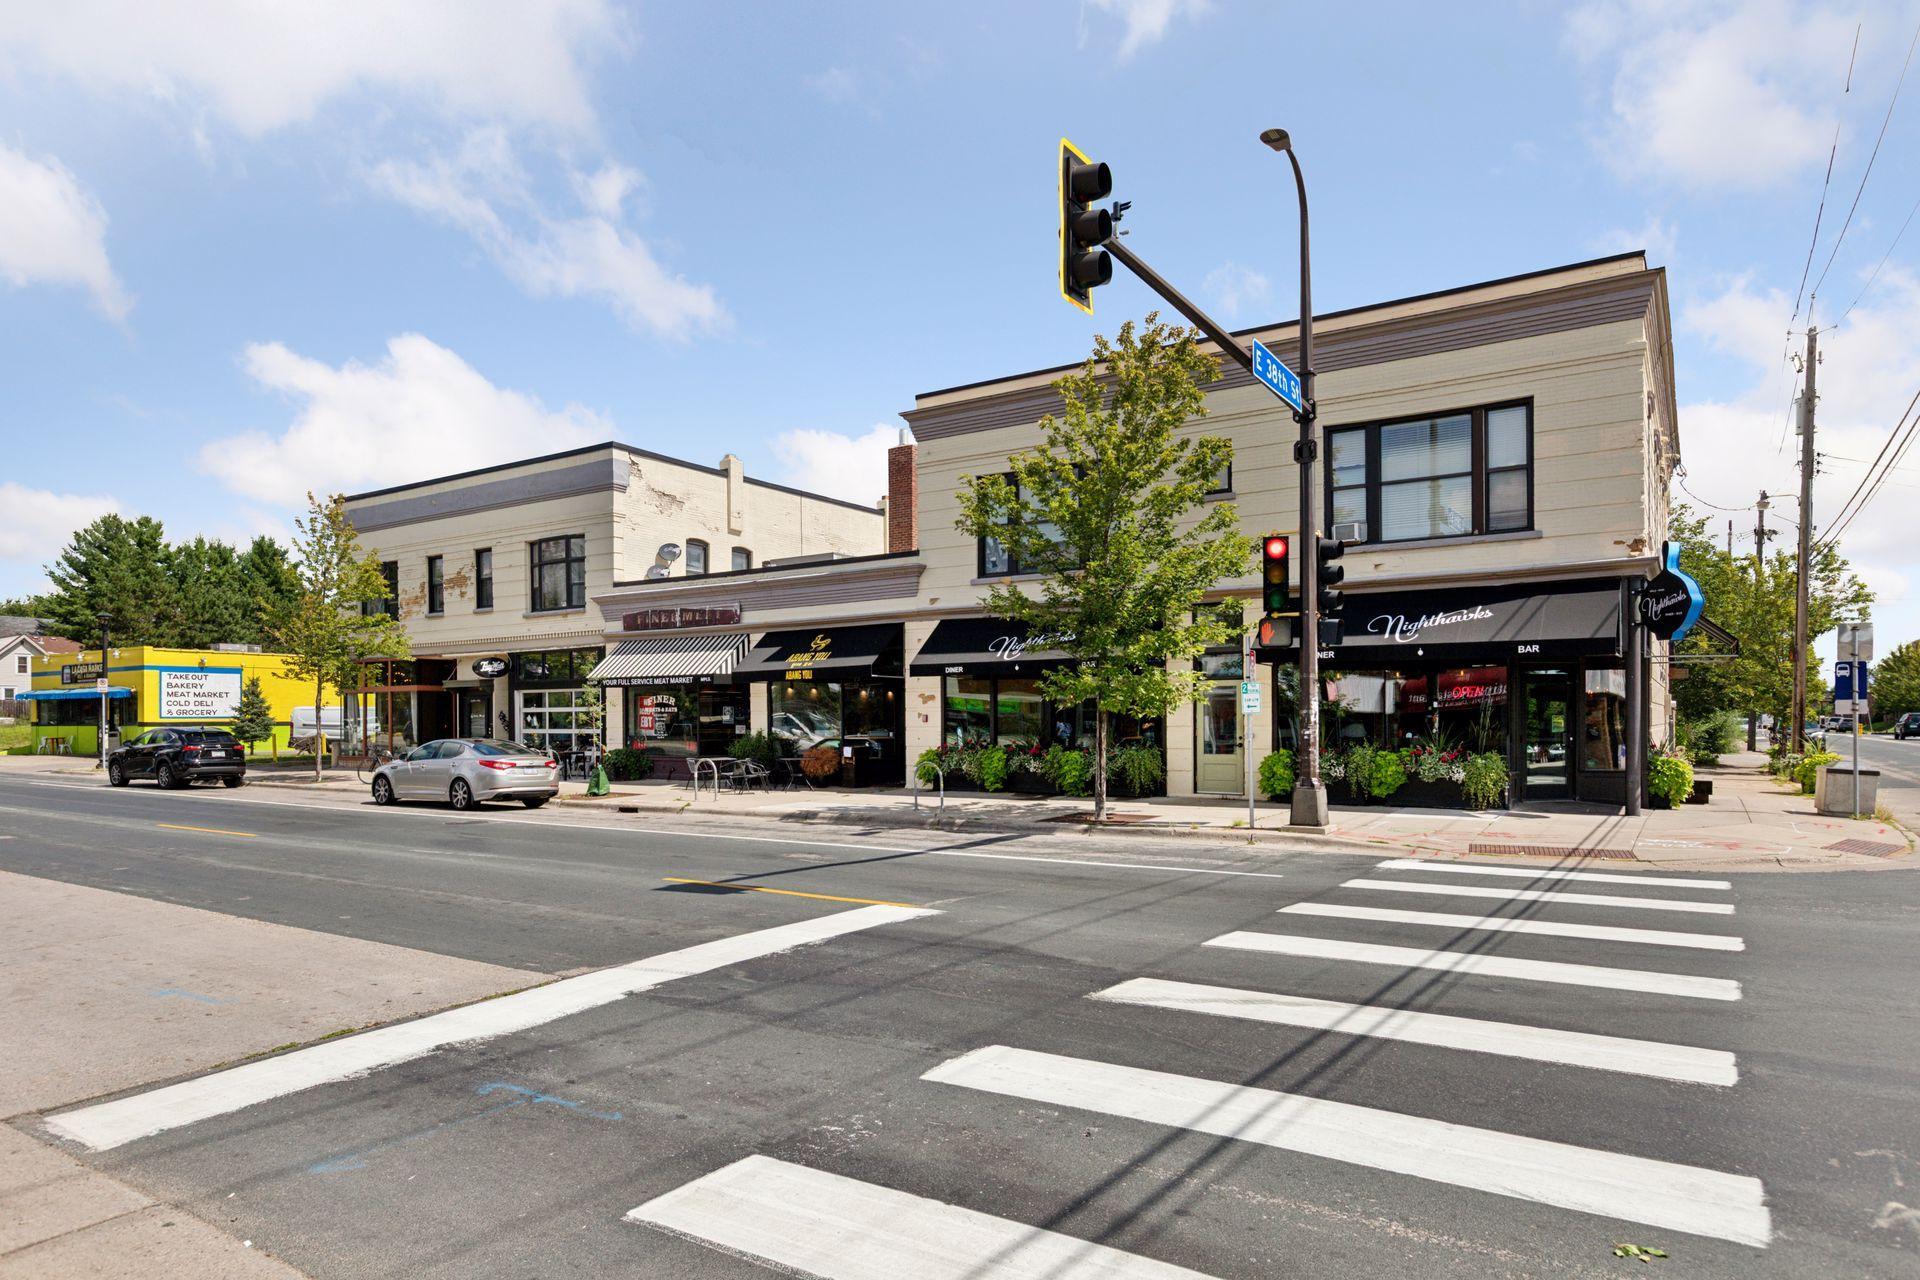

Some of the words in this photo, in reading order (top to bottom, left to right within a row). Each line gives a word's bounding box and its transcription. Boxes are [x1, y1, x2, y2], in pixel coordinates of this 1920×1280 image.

[1256, 349, 1263, 371] E
[1266, 358, 1288, 393] 38th
[1290, 380, 1300, 403] St
[1642, 590, 1687, 621] Nighthawks
[1367, 605, 1494, 643] Nighthawks
[1517, 644, 1540, 654] BAR
[1316, 650, 1335, 659] NER
[785, 670, 801, 680] ABANG
[802, 669, 813, 679] YOLI
[617, 678, 630, 686] FULL
[653, 677, 670, 685] MEAT
[669, 676, 694, 684] MARKET
[193, 691, 230, 699] MARKET
